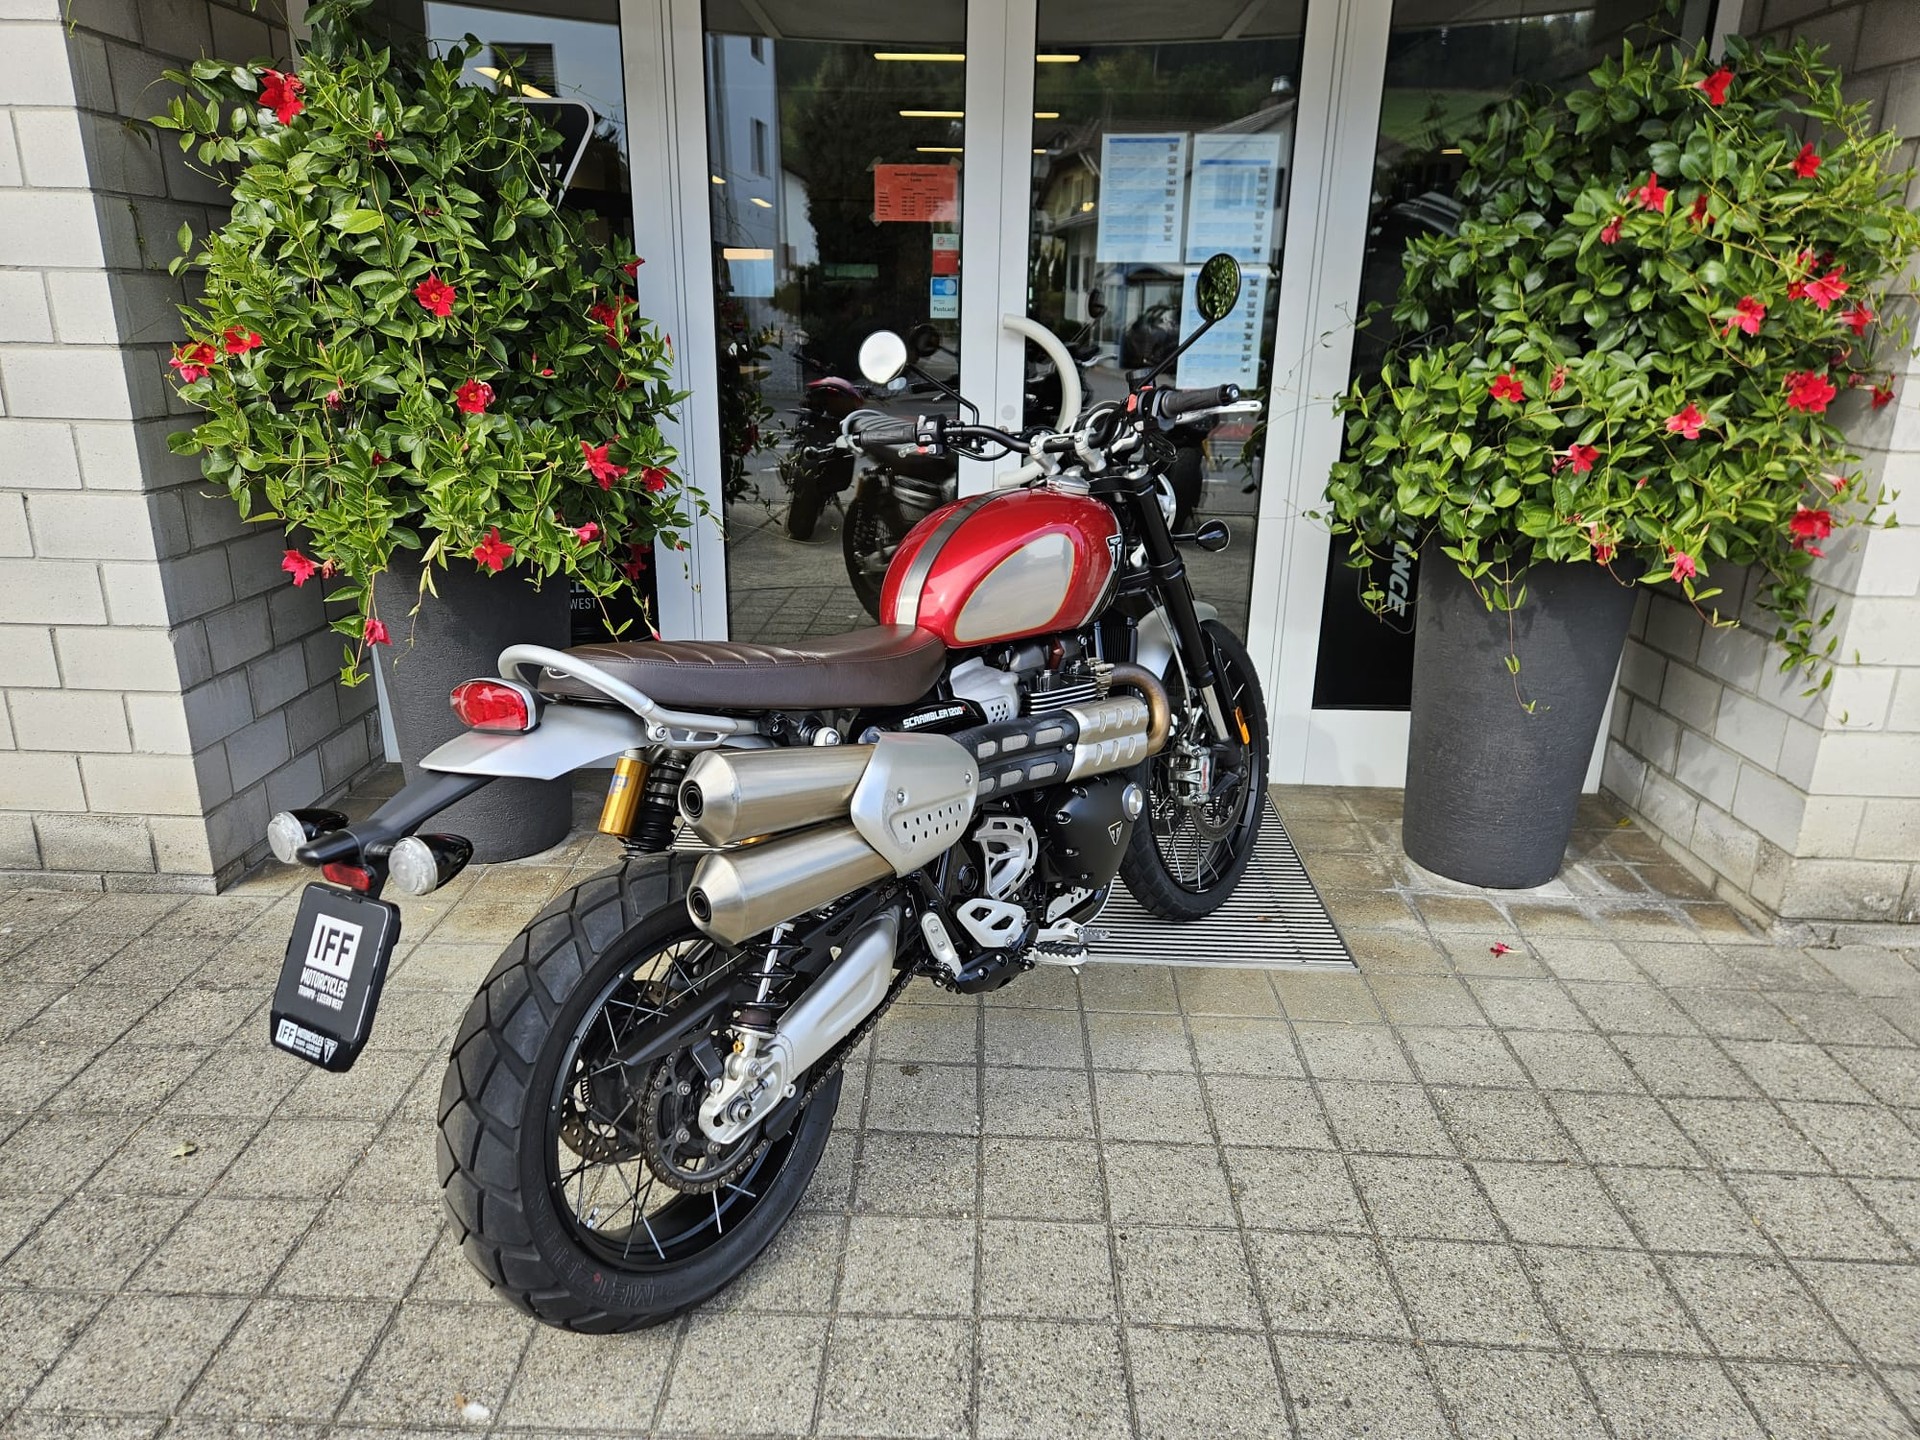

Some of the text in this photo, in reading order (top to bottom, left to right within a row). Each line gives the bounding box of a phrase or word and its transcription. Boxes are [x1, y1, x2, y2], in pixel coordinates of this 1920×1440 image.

[570, 597, 597, 610] WEST
[903, 709, 949, 729] SCRAMBLER
[314, 925, 354, 966] IFF
[300, 966, 348, 1000] MOTORCYCLES
